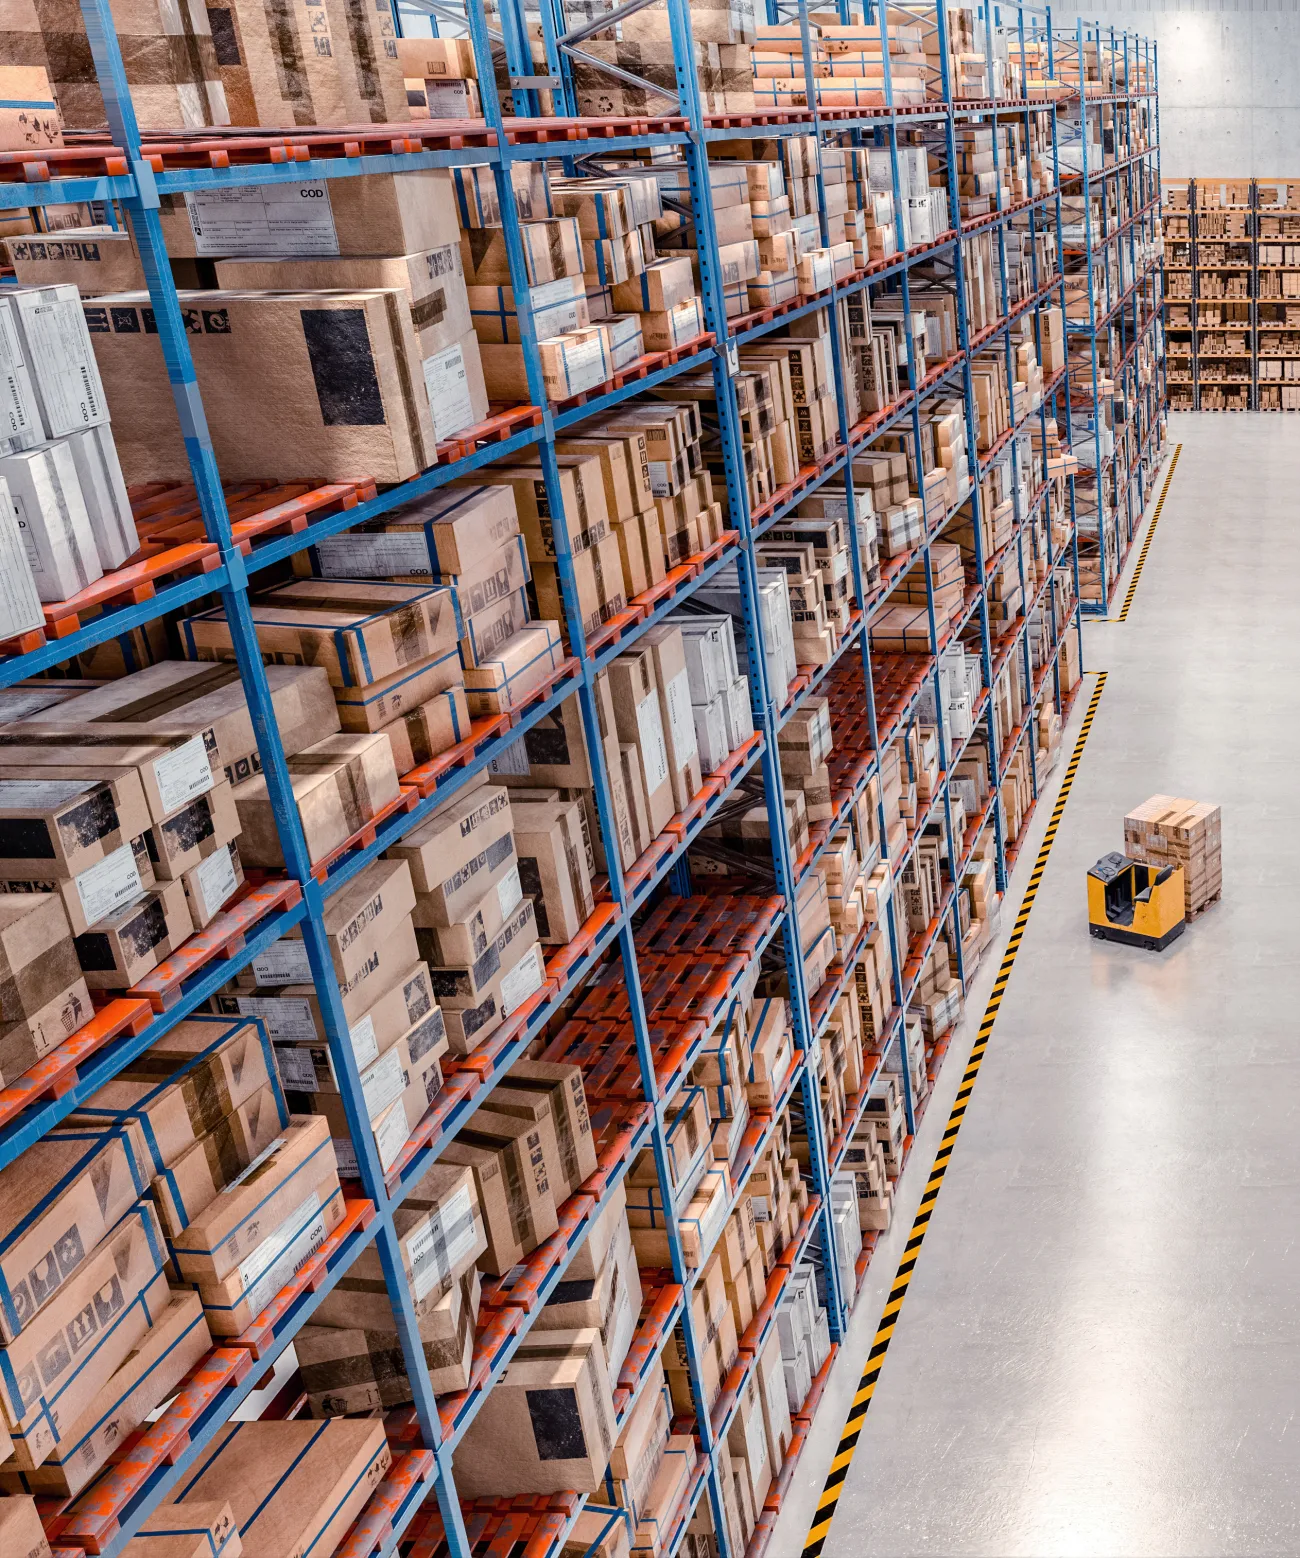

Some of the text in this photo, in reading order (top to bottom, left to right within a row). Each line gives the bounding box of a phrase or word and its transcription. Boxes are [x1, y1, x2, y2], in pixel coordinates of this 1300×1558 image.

[301, 190, 323, 198] COD
[81, 402, 89, 422] COD
[10, 412, 18, 431] COD
[200, 766, 209, 774] COD
[127, 871, 136, 880] COD
[310, 1225, 323, 1240] COD
